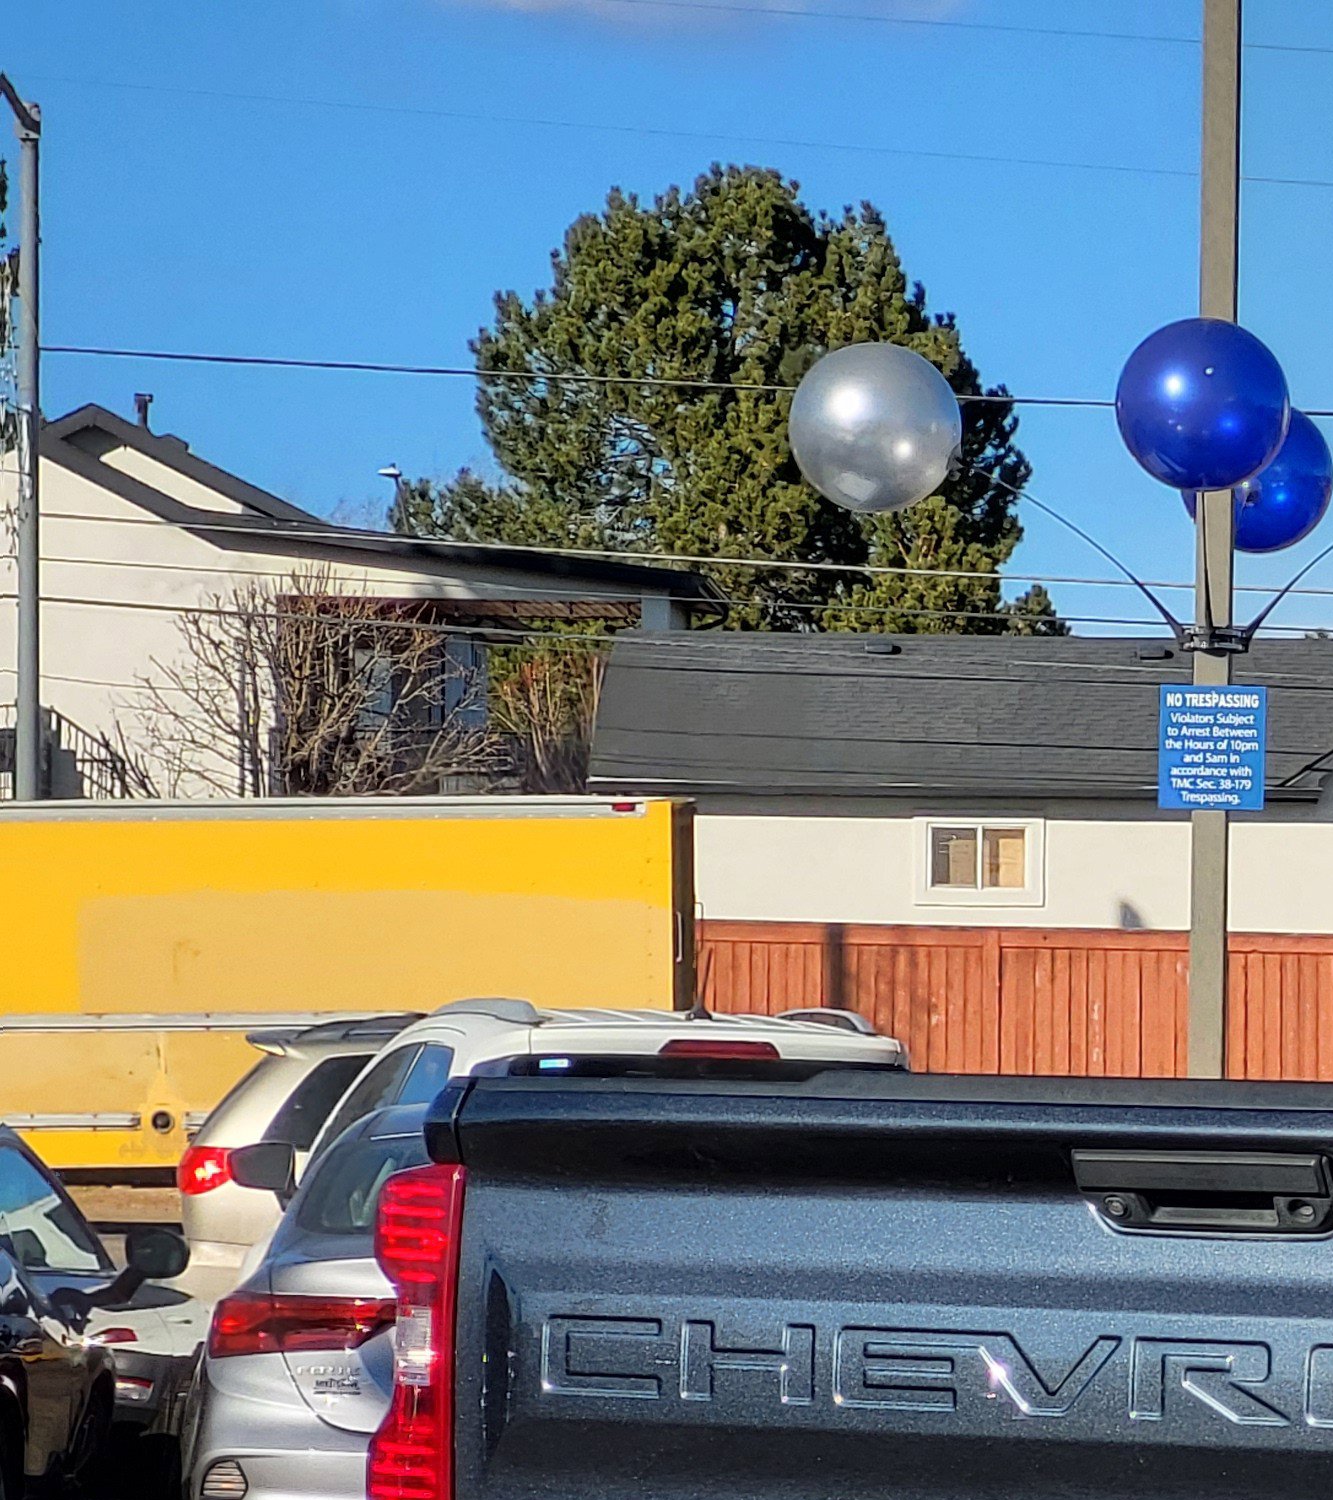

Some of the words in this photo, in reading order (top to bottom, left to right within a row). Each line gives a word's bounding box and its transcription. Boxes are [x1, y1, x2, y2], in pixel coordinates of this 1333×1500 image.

[1166, 693, 1182, 707] NO
[1184, 693, 1259, 708] TRESPASSING
[1170, 712, 1214, 724] Violators
[1216, 713, 1254, 726] Subject
[1167, 726, 1179, 736] to
[1180, 726, 1210, 736] Arrest
[1212, 726, 1257, 737] Between
[1165, 738, 1182, 749] the
[1184, 739, 1214, 749] Hours
[1216, 739, 1228, 749] of
[1230, 739, 1259, 753] 10pm
[1183, 752, 1203, 763] and
[1205, 753, 1228, 763] 5am
[1230, 753, 1240, 763] in
[1170, 766, 1227, 776] accordance
[1229, 766, 1252, 776] with
[1170, 778, 1194, 788] TMC
[1218, 779, 1252, 790] 38-179
[1180, 791, 1241, 805] Trespassing.
